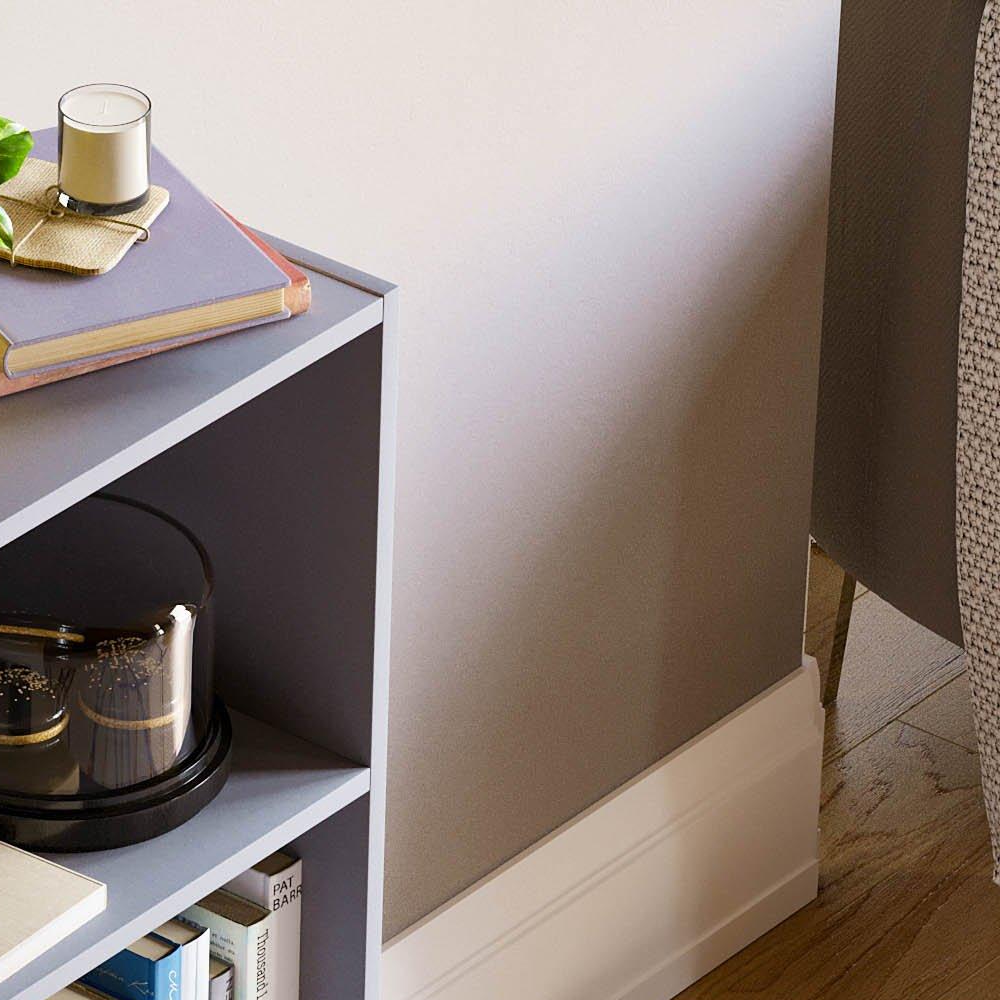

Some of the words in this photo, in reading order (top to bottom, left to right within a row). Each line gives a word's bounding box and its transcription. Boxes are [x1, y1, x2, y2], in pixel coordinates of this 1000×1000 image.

[273, 876, 295, 897] PAT
[273, 885, 302, 912] BARR
[256, 929, 269, 991] Thousand
